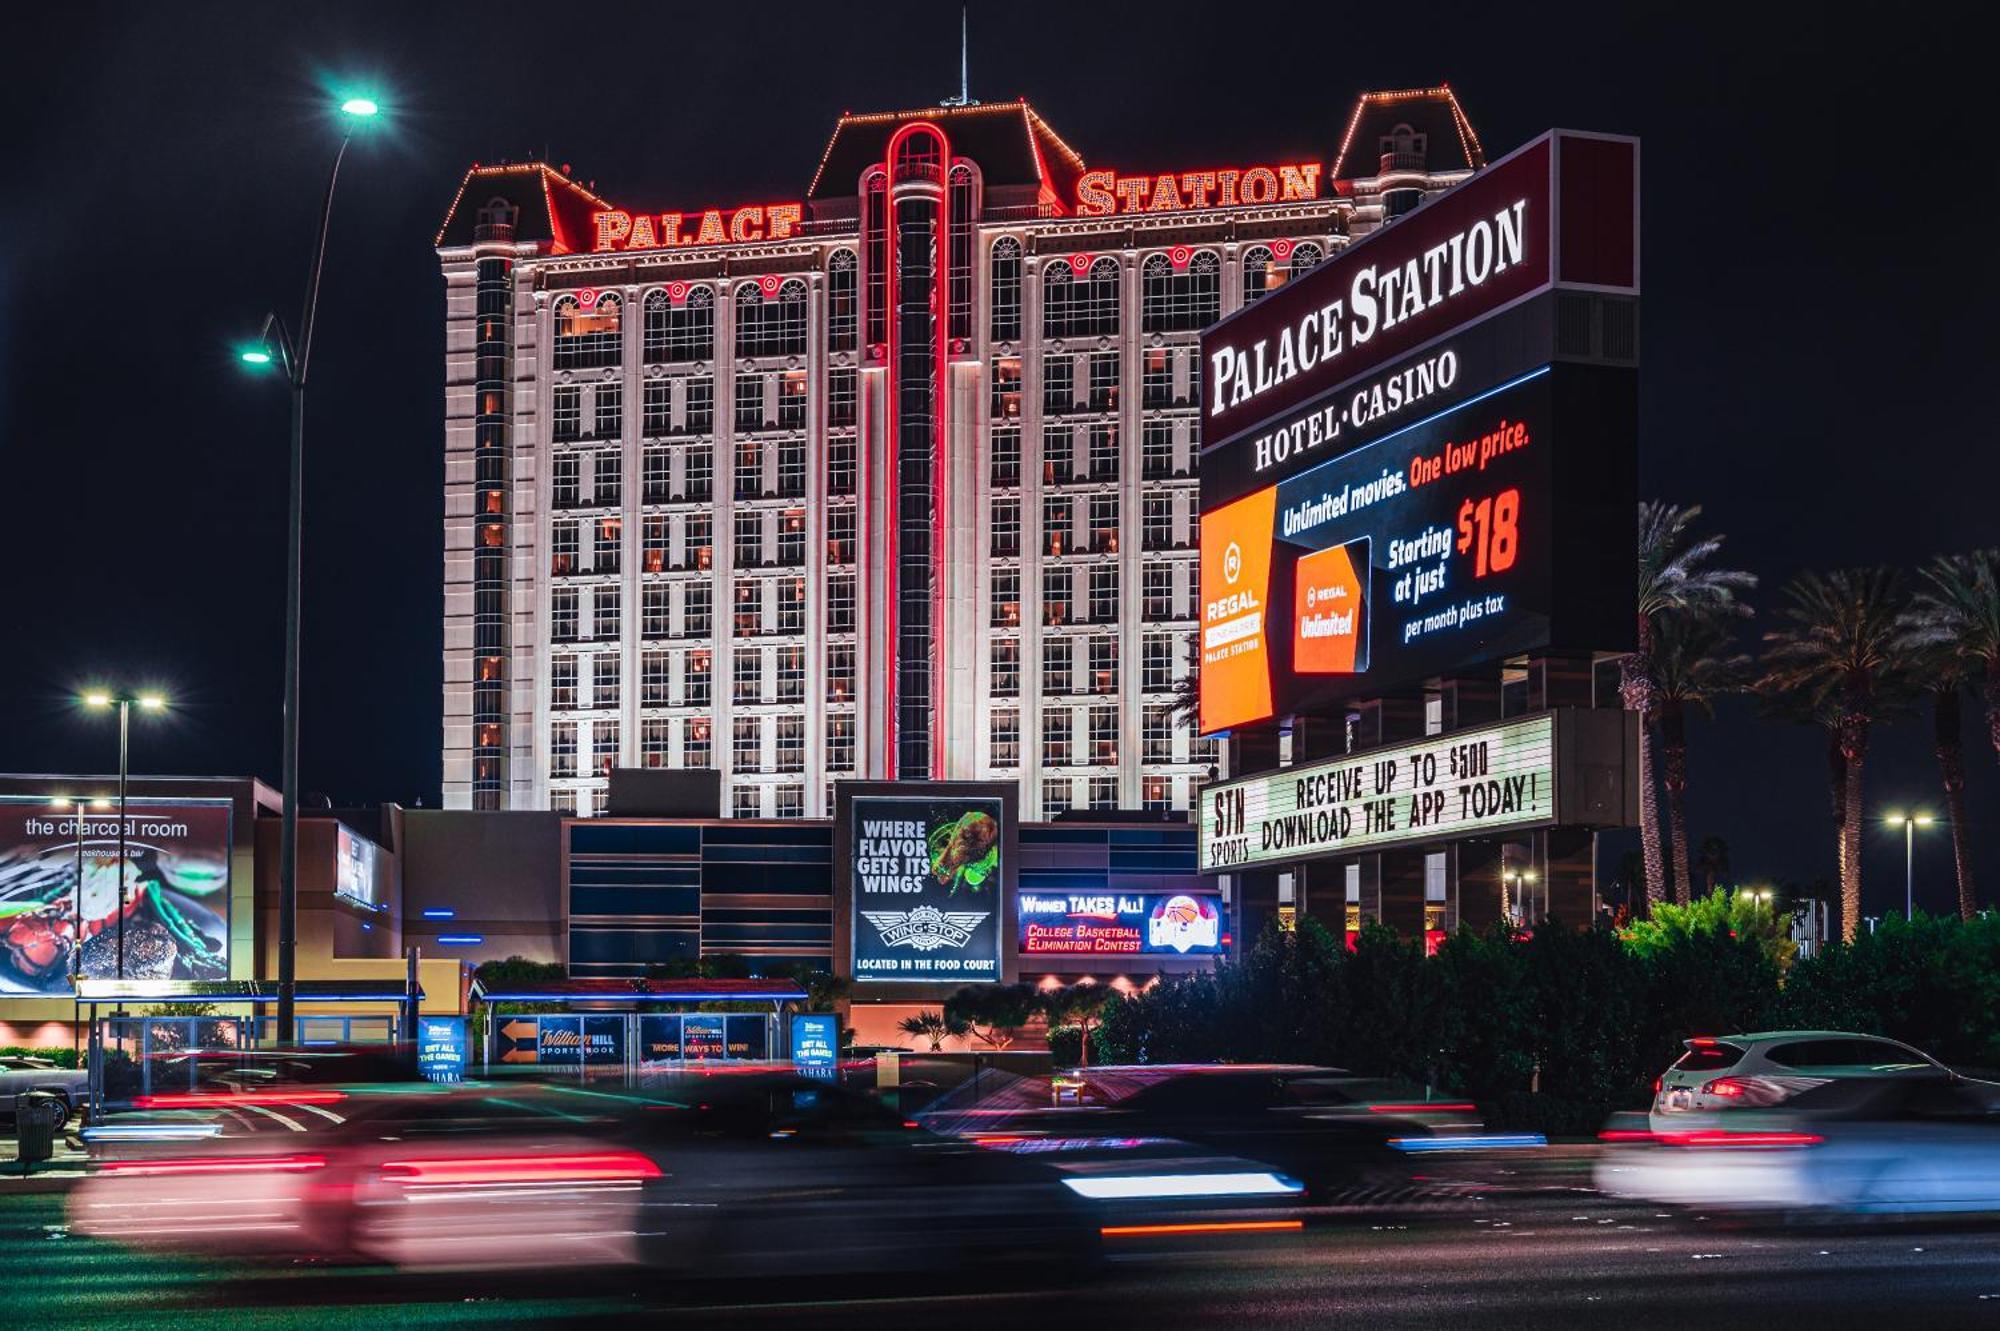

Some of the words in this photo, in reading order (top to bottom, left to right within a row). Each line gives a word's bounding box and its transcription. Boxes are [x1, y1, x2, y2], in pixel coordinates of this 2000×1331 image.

[1077, 163, 1321, 215] STATION
[1211, 299, 1343, 417] PALACE
[1350, 199, 1527, 347] STATION
[1283, 484, 1349, 536] Unlimited
[1350, 469, 1407, 511] movies.
[1409, 456, 1441, 488] One
[1445, 442, 1477, 474] low
[1480, 420, 1530, 471] price.
[1457, 488, 1520, 578] $18
[1388, 526, 1452, 570] Starting
[1394, 570, 1411, 602] at
[1414, 562, 1446, 605] just
[1207, 588, 1260, 623] REGAL
[1301, 608, 1353, 639] Unlimited
[1404, 620, 1422, 644] per
[1424, 610, 1457, 634] month
[1459, 600, 1483, 629] plus
[1485, 594, 1505, 616] tax
[1296, 765, 1364, 810] RECEIVE
[1375, 759, 1397, 795] UP
[1410, 752, 1436, 788] TO
[1450, 741, 1488, 780] $500
[1214, 787, 1246, 838] STN
[1261, 808, 1351, 851] DOWNLOAD
[1363, 797, 1396, 834] THE
[1409, 790, 1445, 828] APP
[25, 818, 54, 836] the
[58, 818, 136, 836] charcoal
[141, 822, 188, 837] room
[863, 820, 926, 838] WHERE
[860, 839, 928, 857] FLAVOR
[1210, 837, 1249, 867] SPORTS
[857, 858, 900, 874] GETS
[905, 858, 930, 875] ITS
[862, 875, 923, 893] WINGS
[1069, 896, 1115, 914] TAKES
[1027, 924, 1075, 938] COLLEGE
[1076, 924, 1141, 938] BASKETBALL
[1027, 938, 1093, 951] ELIMINATION
[1095, 938, 1142, 951] CONTEST
[857, 960, 898, 969] LOCATED
[901, 960, 912, 969] IN
[915, 960, 932, 970] THE
[934, 960, 961, 970] FOOD
[963, 960, 996, 970] COURT
[540, 1029, 592, 1046] William
[592, 1034, 615, 1045] HILL
[652, 1043, 680, 1052] MORE
[685, 1044, 710, 1053] WAYS
[711, 1044, 723, 1053] TO
[540, 1046, 581, 1055] SPORTS
[585, 1046, 615, 1054] BOOK
[421, 1072, 461, 1083] AHARA
